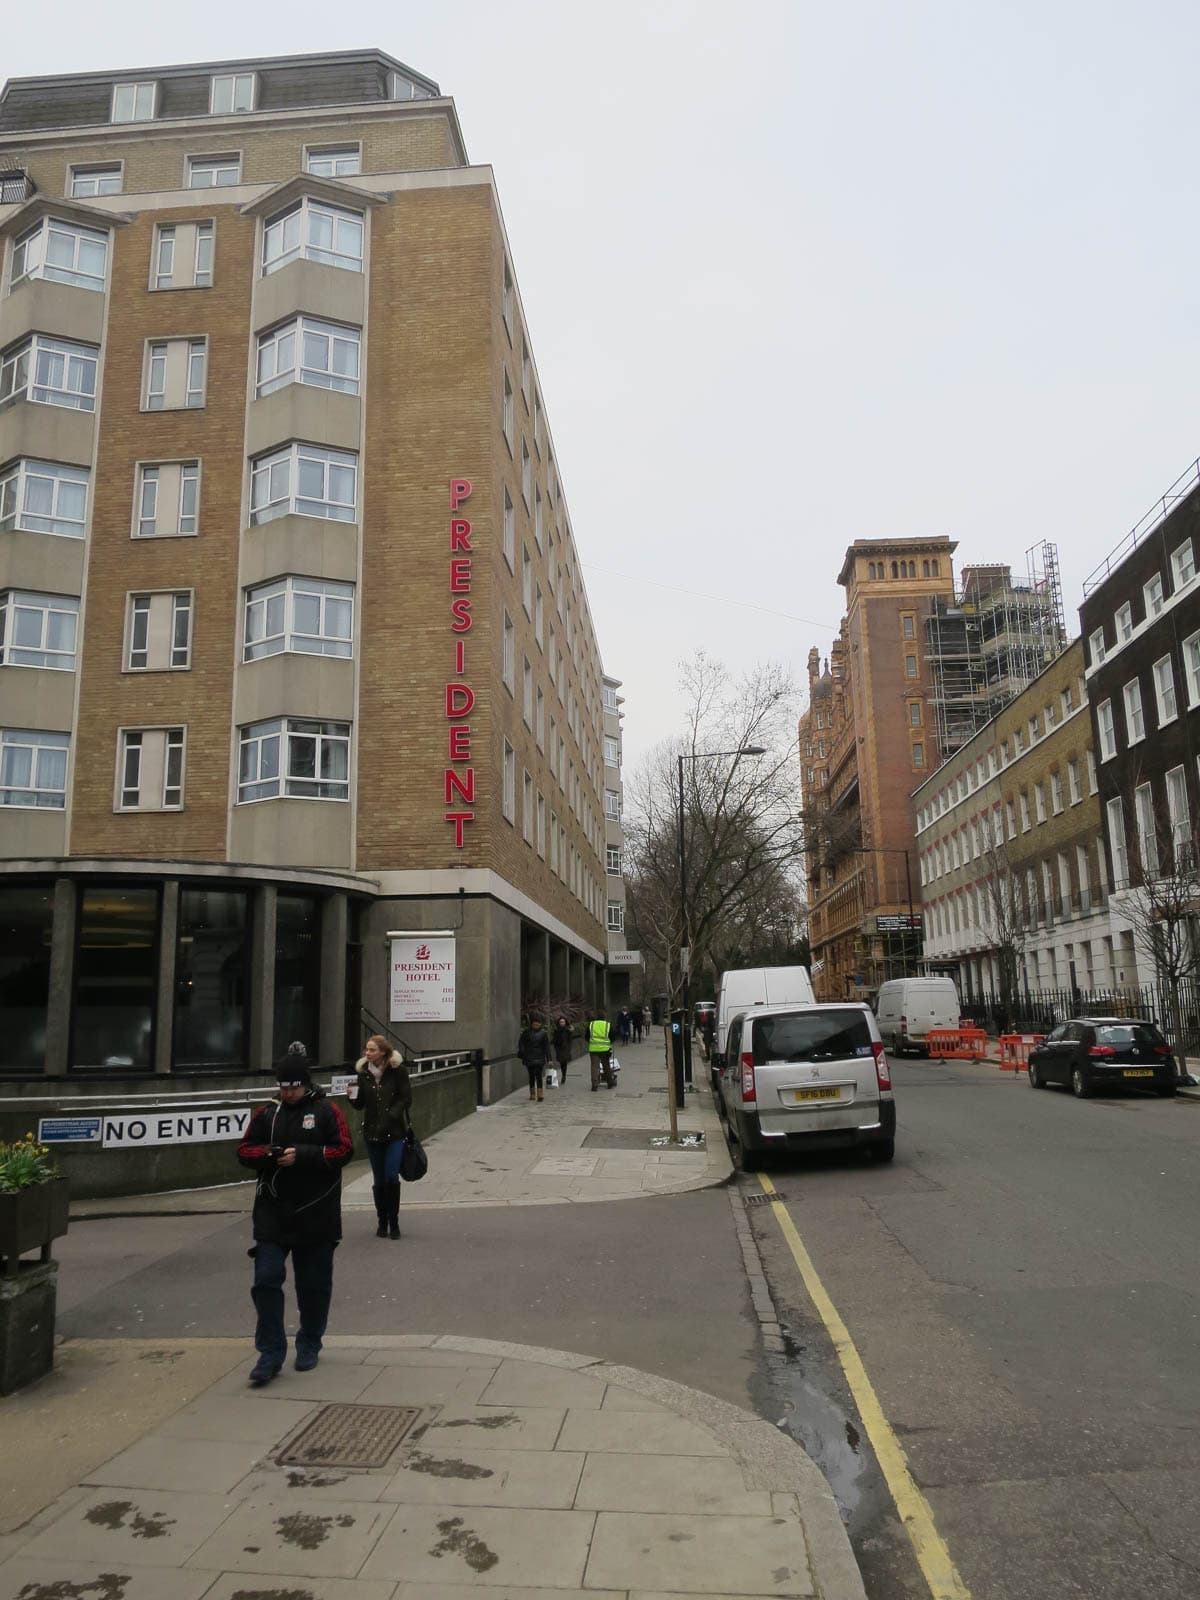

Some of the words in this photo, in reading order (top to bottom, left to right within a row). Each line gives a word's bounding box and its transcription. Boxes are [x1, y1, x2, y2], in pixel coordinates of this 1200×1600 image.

[445, 479, 475, 849] PRESIDENT
[394, 963, 451, 971] PRESIDENT
[406, 973, 441, 982] HOTEL
[672, 1023, 679, 1033] P
[105, 1120, 147, 1141] NO
[157, 1113, 248, 1139] ENTRY
